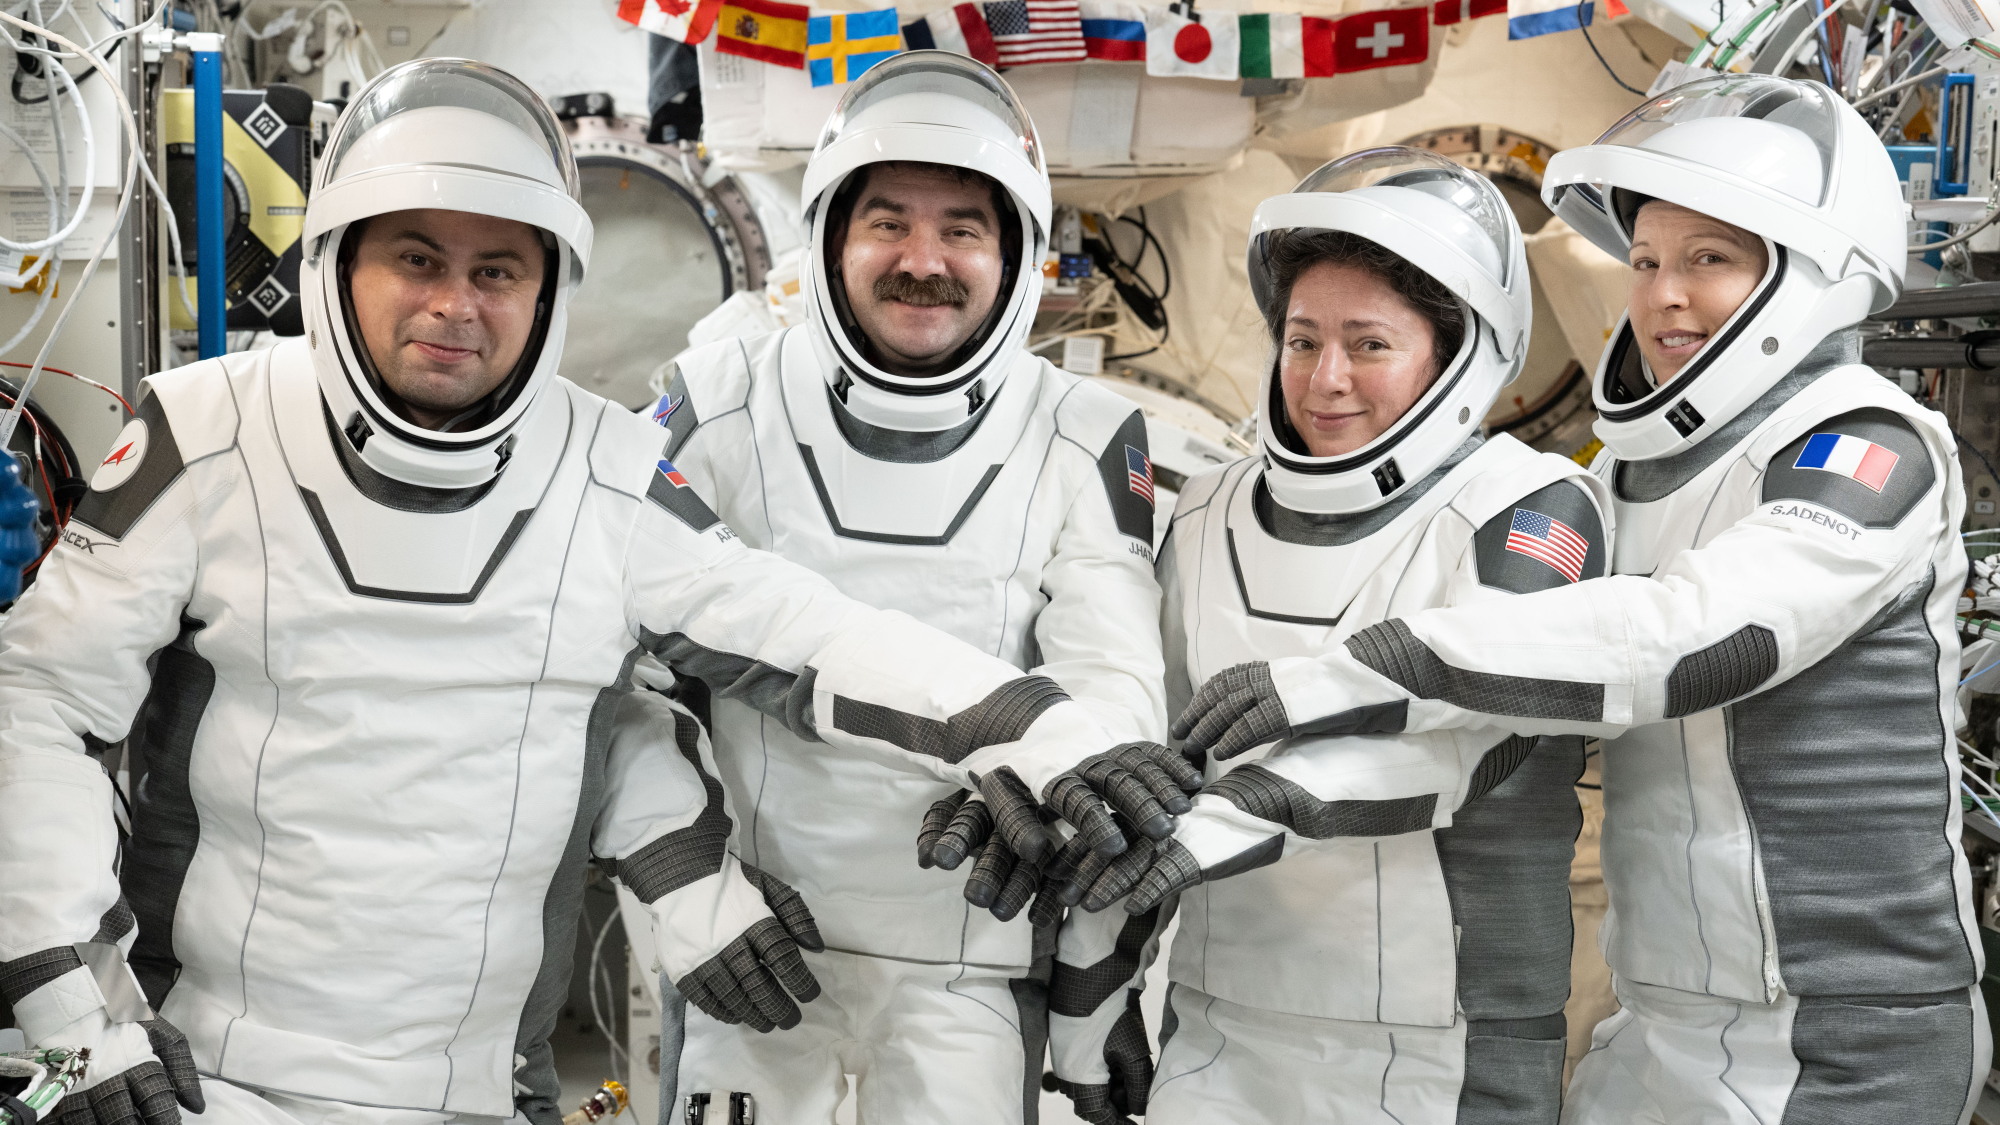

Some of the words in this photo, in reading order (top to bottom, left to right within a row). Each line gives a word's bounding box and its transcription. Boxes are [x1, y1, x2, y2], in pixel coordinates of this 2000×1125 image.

[1770, 505, 1862, 541] S.ADENOT
[59, 528, 119, 554] ACEX
[1129, 542, 1155, 565] J.HAT
